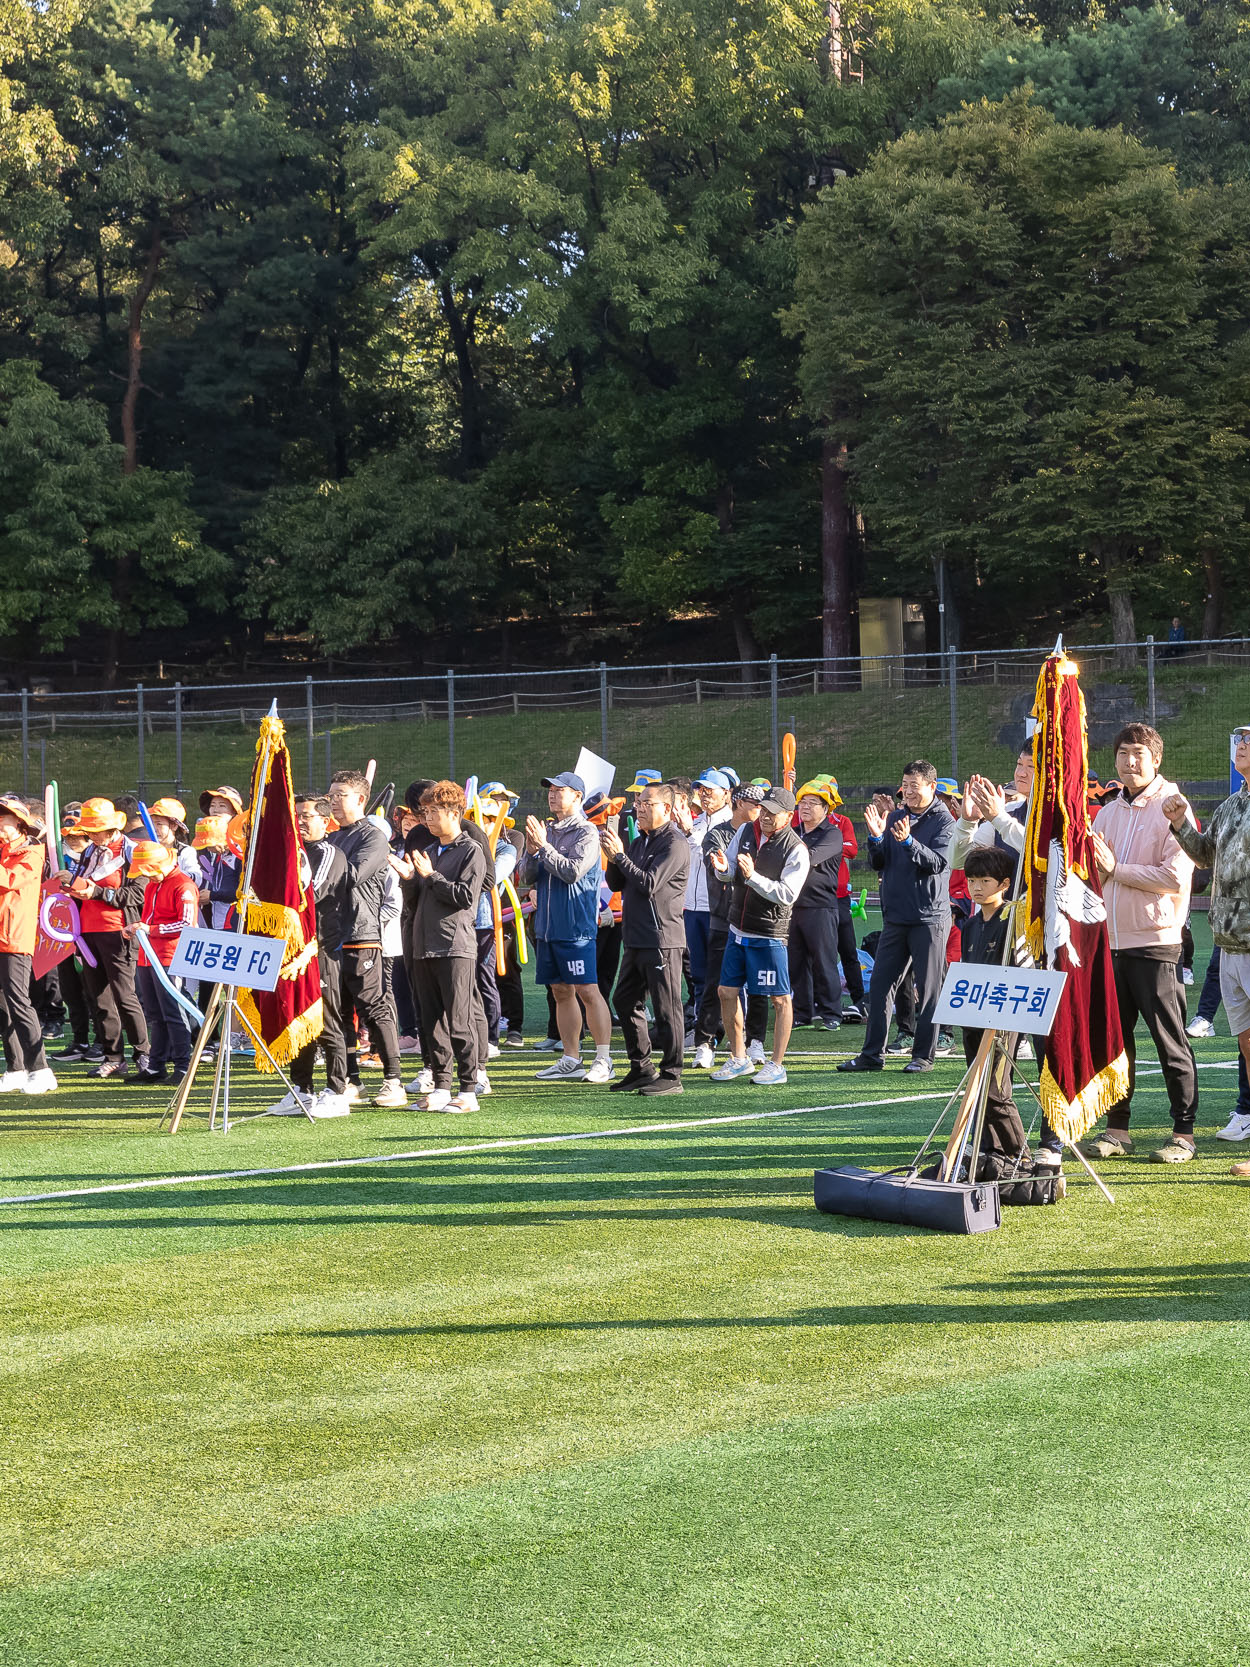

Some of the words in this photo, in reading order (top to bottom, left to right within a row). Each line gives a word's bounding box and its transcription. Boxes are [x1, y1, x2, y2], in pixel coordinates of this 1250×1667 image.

[184, 939, 242, 972] 대공원
[247, 950, 271, 975] FC
[567, 959, 585, 976] 48
[757, 970, 777, 985] 50
[949, 979, 1051, 1017] 용마축구회
